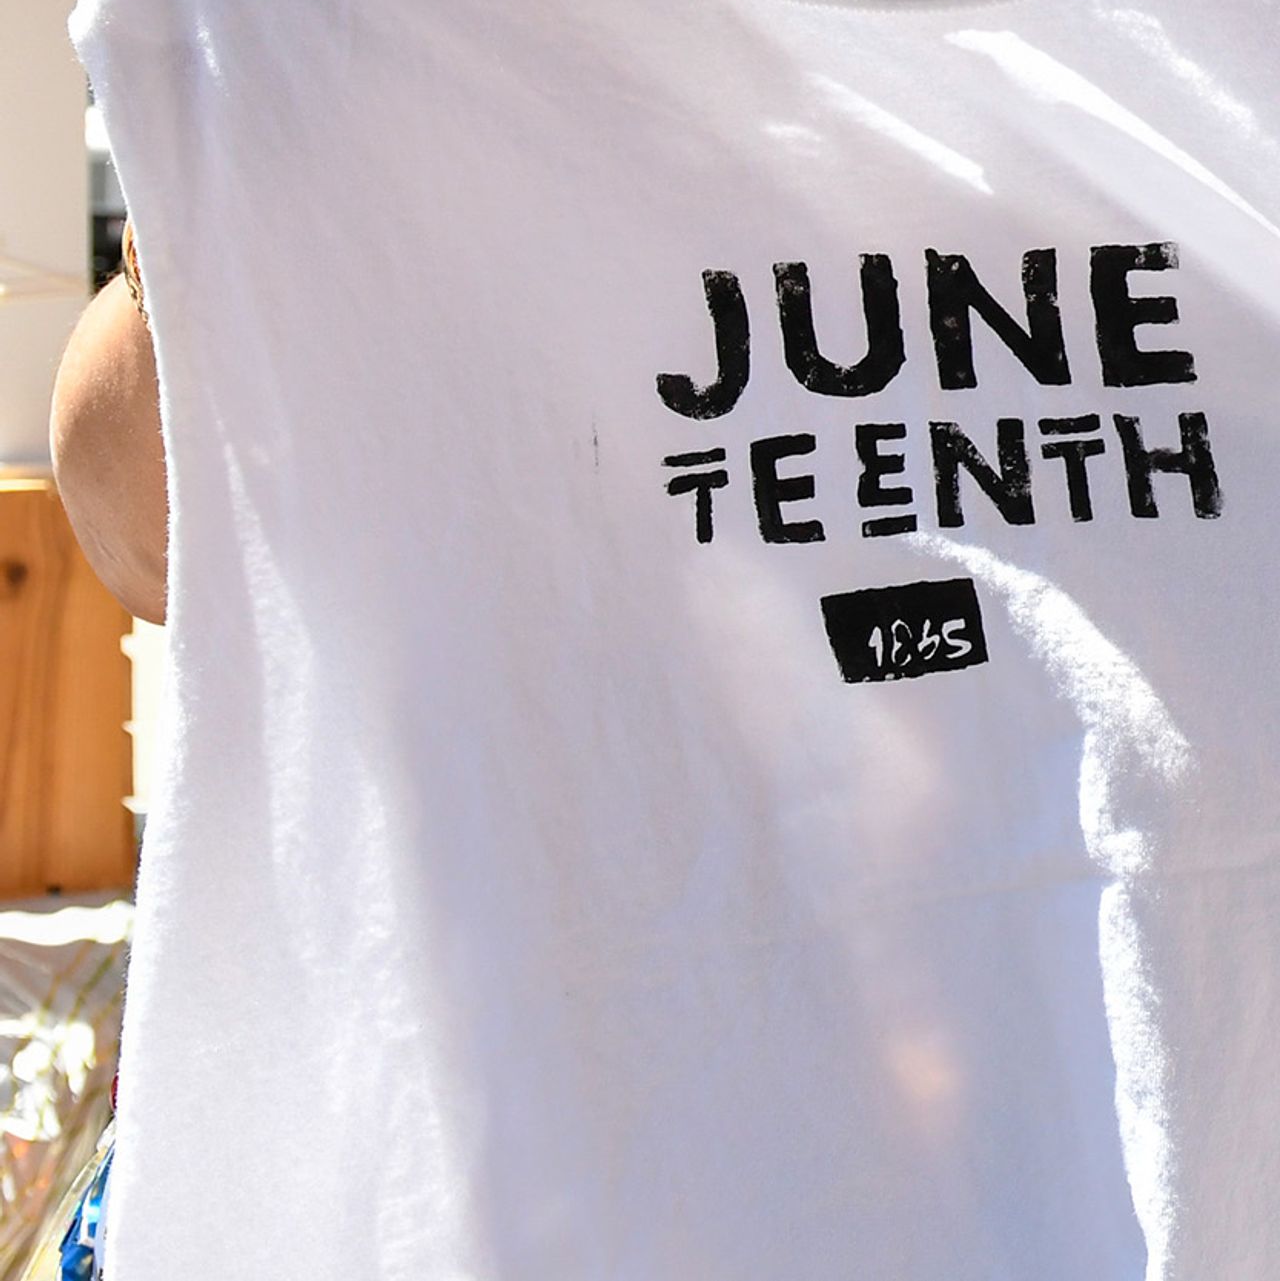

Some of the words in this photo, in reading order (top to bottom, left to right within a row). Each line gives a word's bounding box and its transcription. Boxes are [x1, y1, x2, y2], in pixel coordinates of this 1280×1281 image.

[656, 241, 1198, 421] JUNE
[661, 411, 1225, 545] TEENTH
[867, 618, 973, 668] 1865
